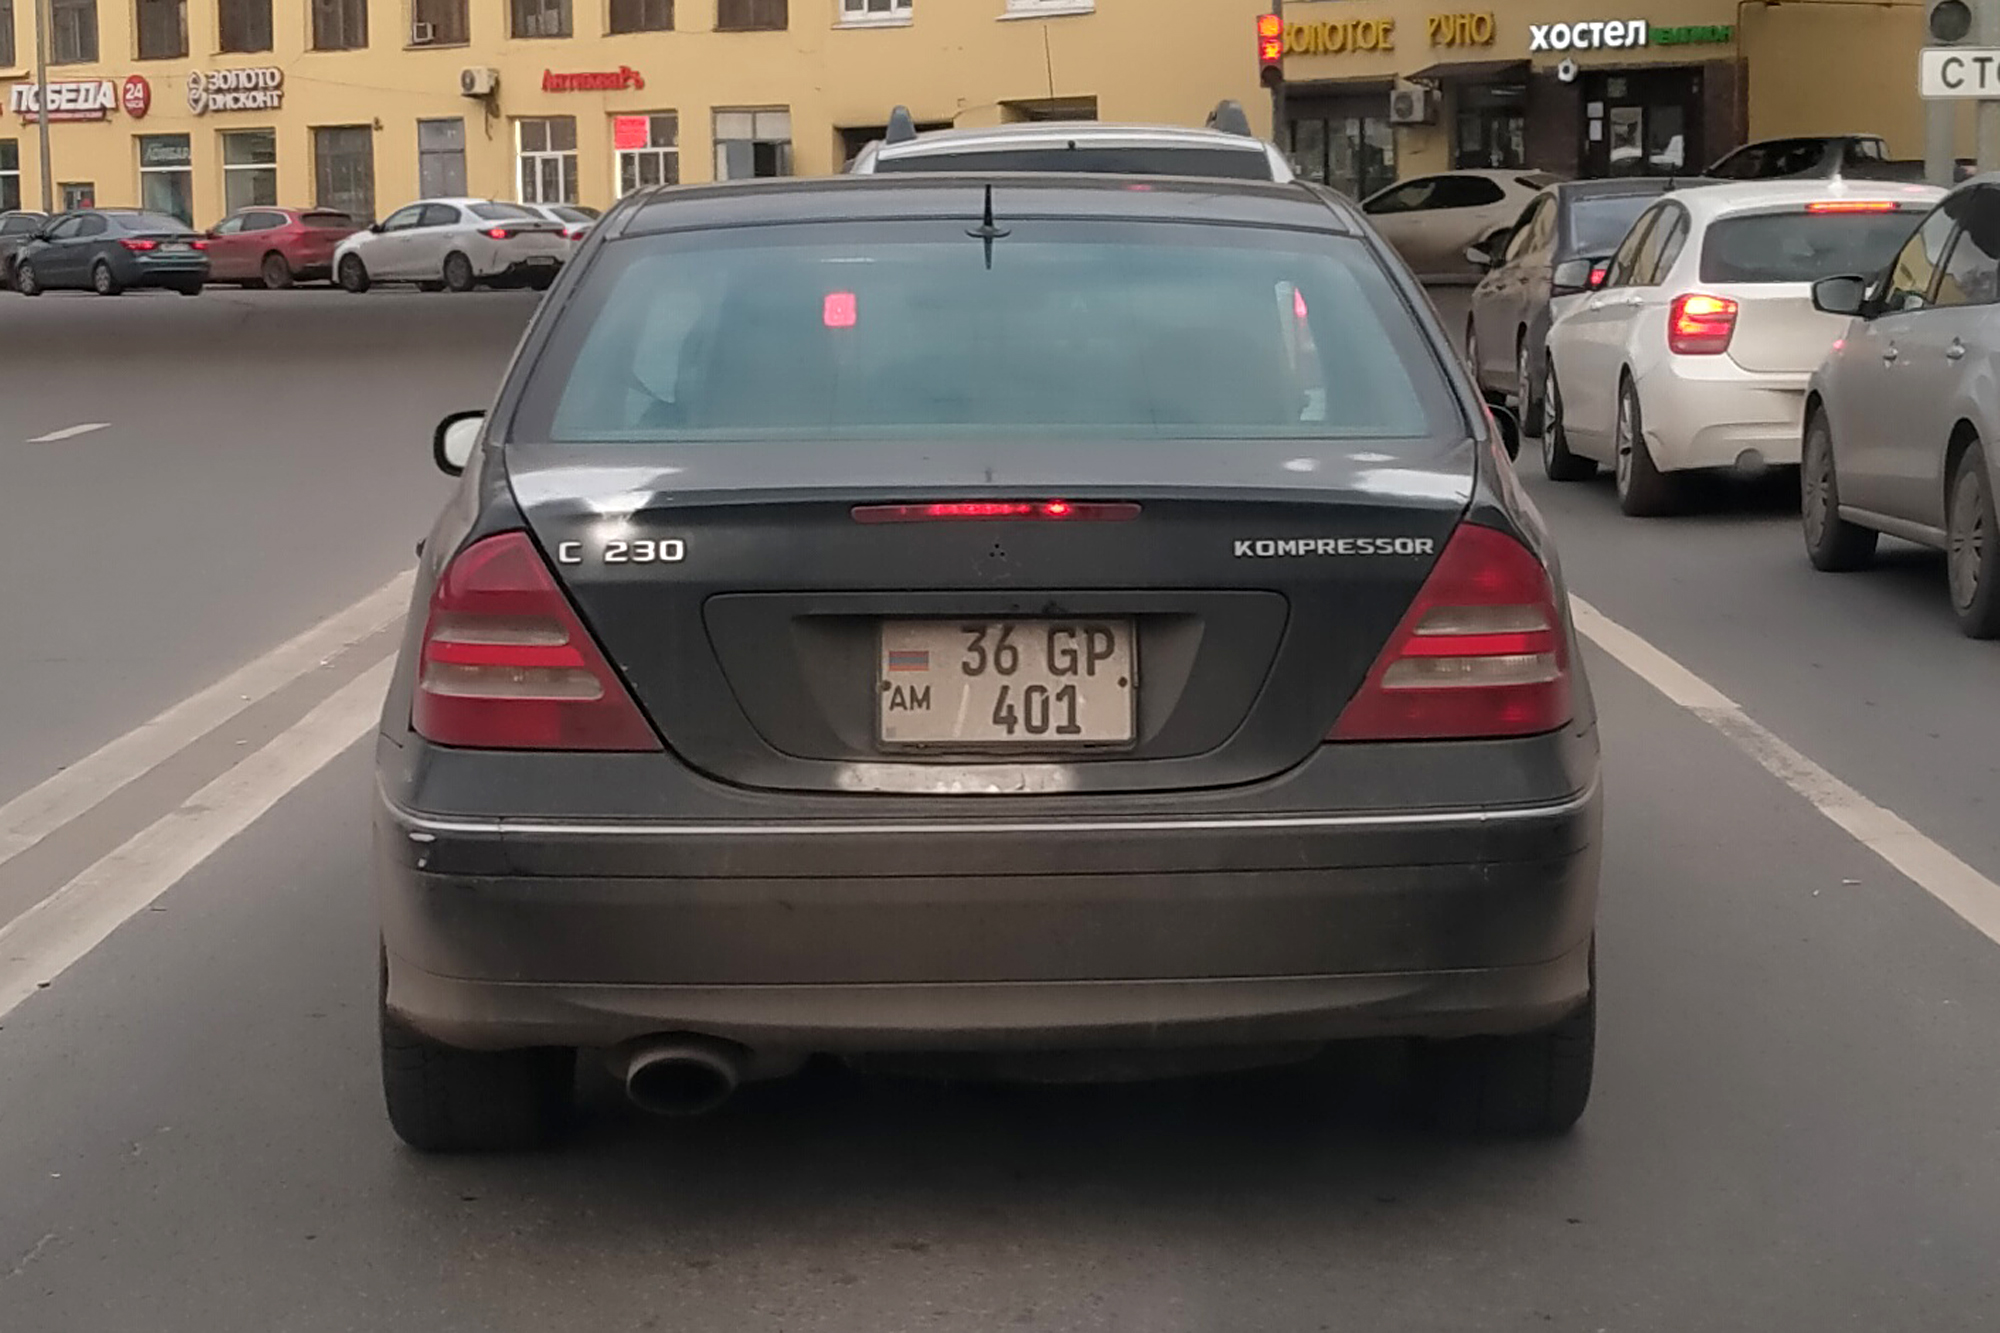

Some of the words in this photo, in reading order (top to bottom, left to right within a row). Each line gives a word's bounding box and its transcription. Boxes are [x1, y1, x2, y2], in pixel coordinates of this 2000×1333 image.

[1427, 12, 1494, 47] РУНО
[208, 68, 281, 90] ЗОЛОТО
[1941, 56, 2000, 89] СТ
[125, 83, 143, 99] 24
[558, 541, 582, 563] C
[604, 539, 684, 562] 230
[1233, 537, 1434, 557] KOMPRESSOR
[961, 624, 1019, 677] 36
[1047, 625, 1116, 677] GP
[889, 685, 931, 711] AM
[992, 684, 1082, 735] 401
